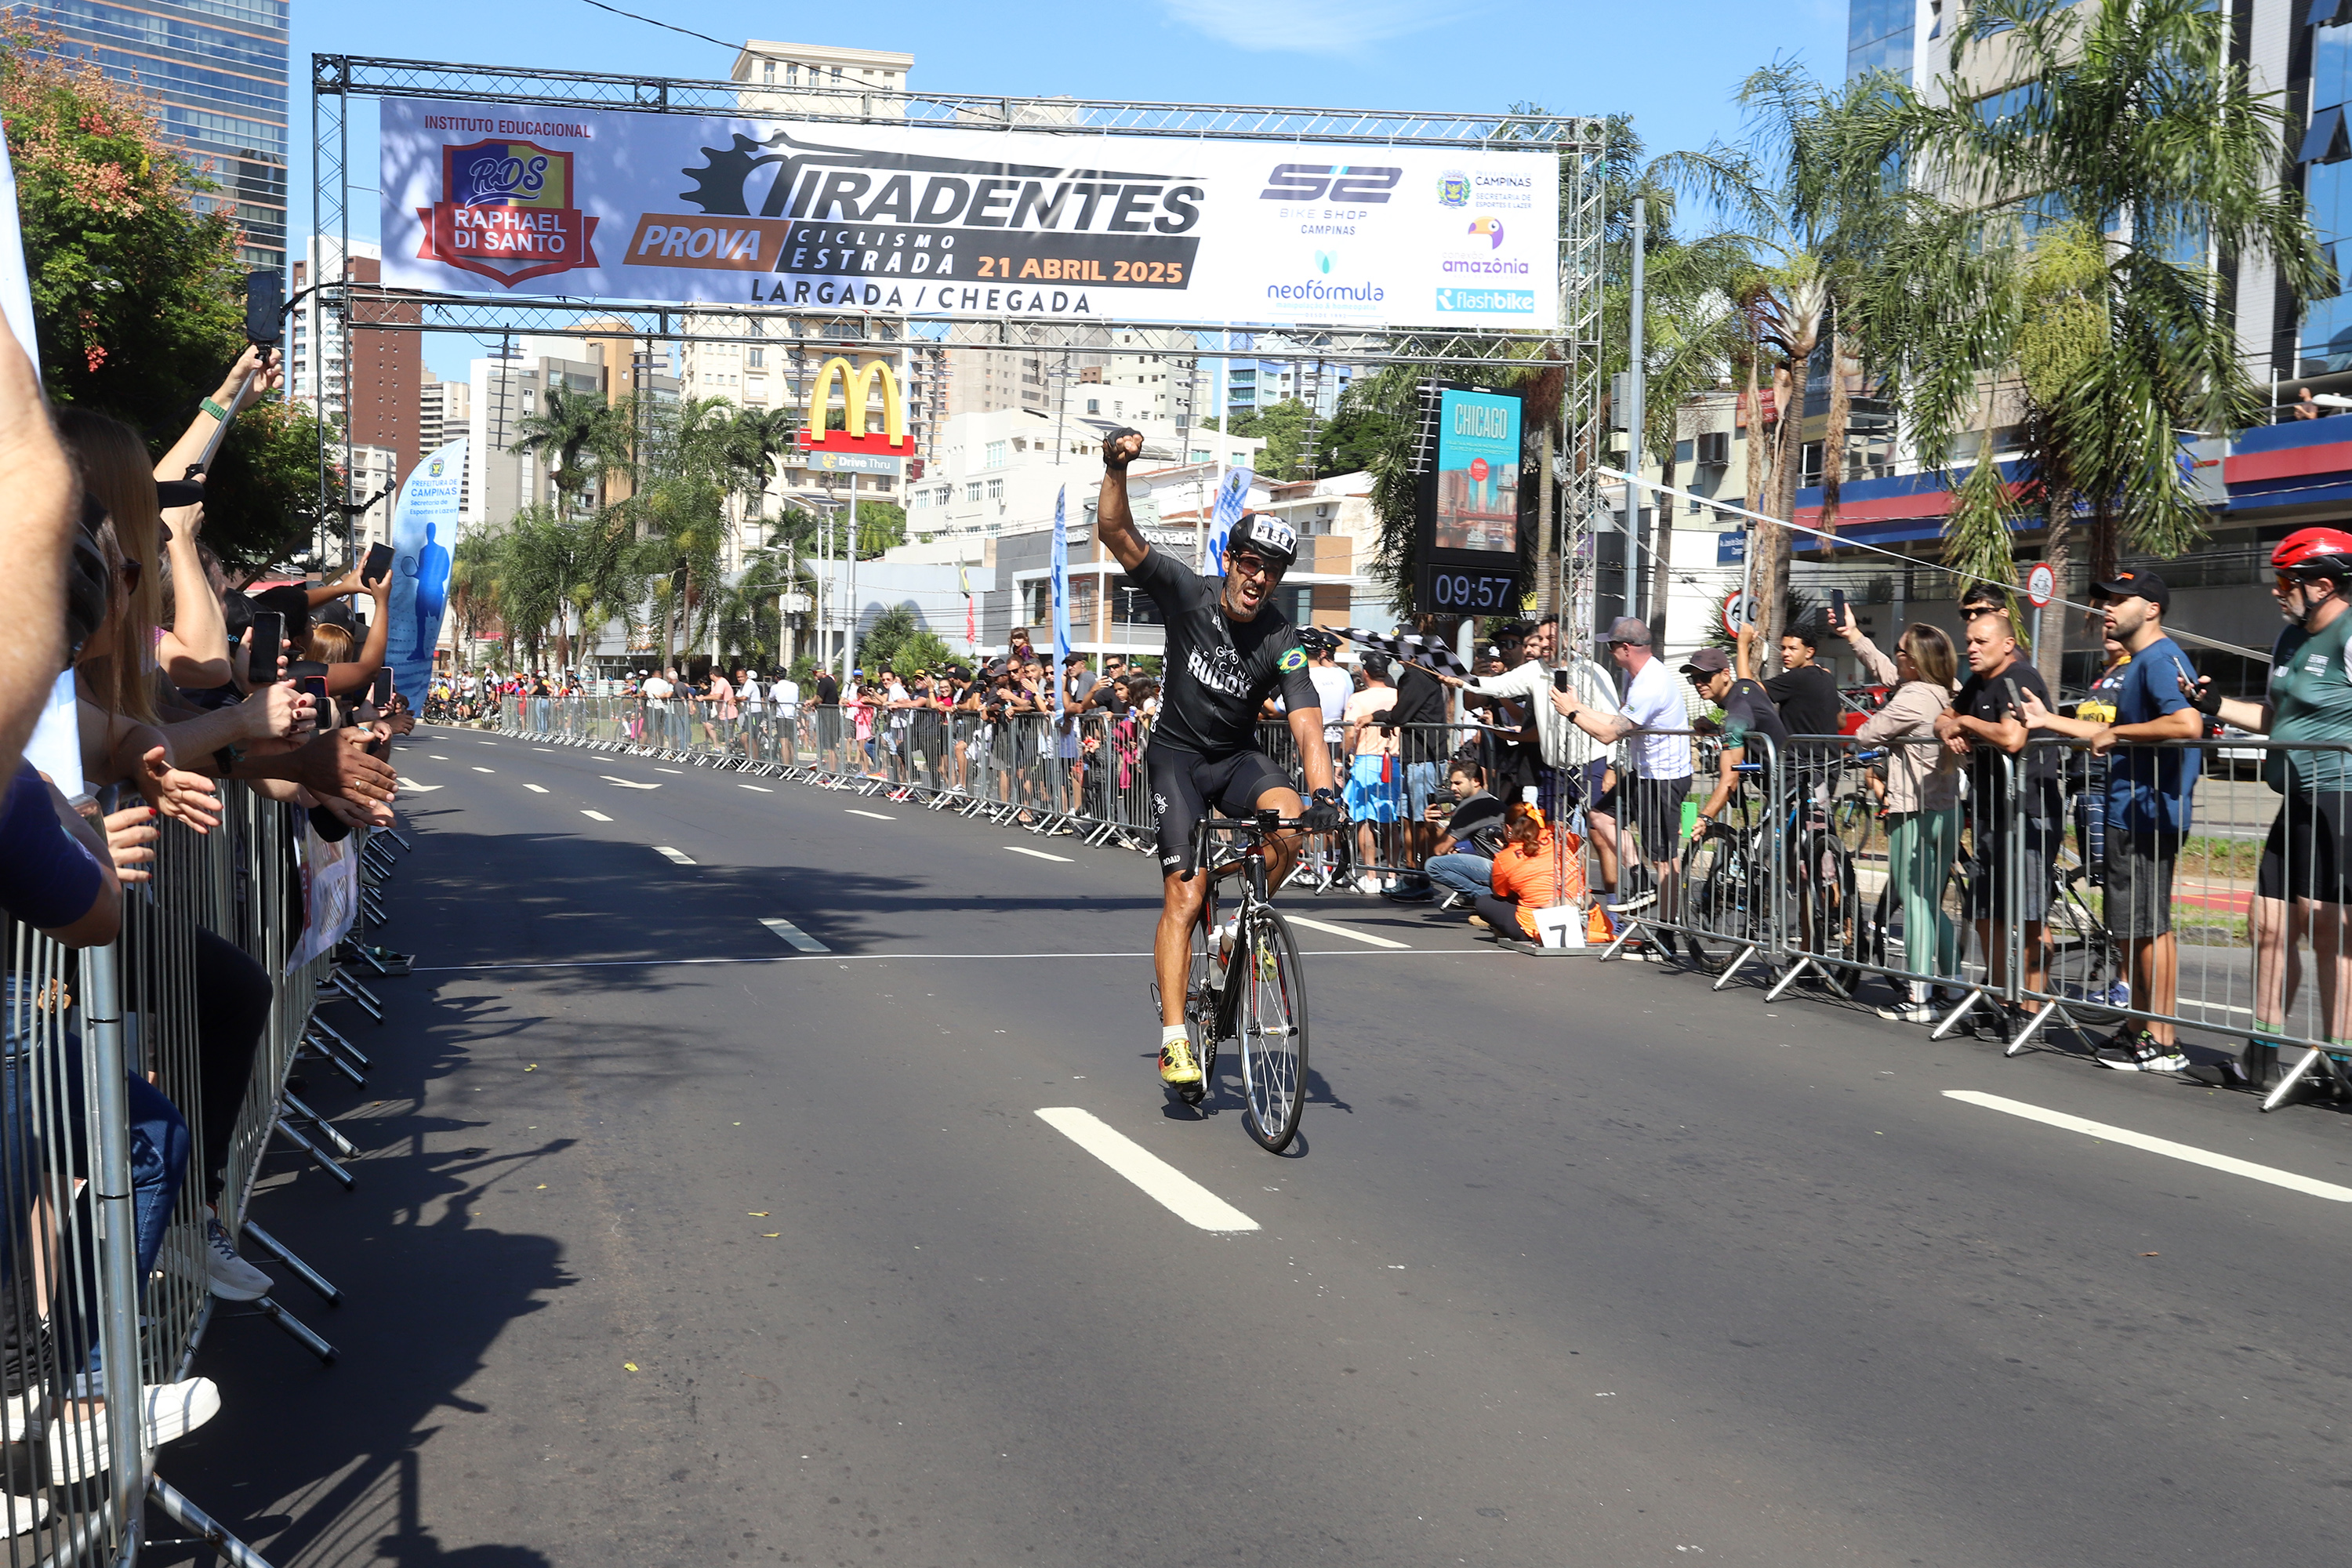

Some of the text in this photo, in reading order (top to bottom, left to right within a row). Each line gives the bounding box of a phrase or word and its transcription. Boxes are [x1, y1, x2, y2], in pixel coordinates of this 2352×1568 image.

[425, 115, 591, 139] INSTITUTO EDUCACIONAL
[470, 155, 549, 194] RDS
[1259, 163, 1403, 204] S2
[1475, 176, 1532, 187] CAMPINAS
[754, 153, 1206, 234] TIRADENTES
[1475, 192, 1520, 201] SECRETARIA
[454, 209, 567, 233] RAPHAEL
[1279, 208, 1367, 220] BIKE SHOP
[454, 230, 566, 253] DI SANTO
[797, 228, 956, 250] CICLISMO
[1301, 224, 1356, 236] CAMPINAS
[637, 225, 761, 261] PROVA
[790, 247, 954, 275] ESTRADA
[977, 256, 1184, 284] 21 ABRIL 2025
[1442, 257, 1529, 274] amazônia
[750, 278, 1091, 314] LARGADA / CHEGADA
[1267, 279, 1385, 302] neofórmula
[1457, 291, 1534, 310] flashbike
[1454, 403, 1508, 440] CHICAGO
[838, 456, 891, 470] Drive Thru
[411, 487, 458, 497] CAMPINAS
[412, 479, 448, 488] PREFEITURA
[409, 508, 434, 517] Esportes
[1262, 526, 1290, 547] 158
[1435, 574, 1512, 609] 09:57
[1193, 644, 1254, 684] OFICINA
[1548, 924, 1567, 948] 7
